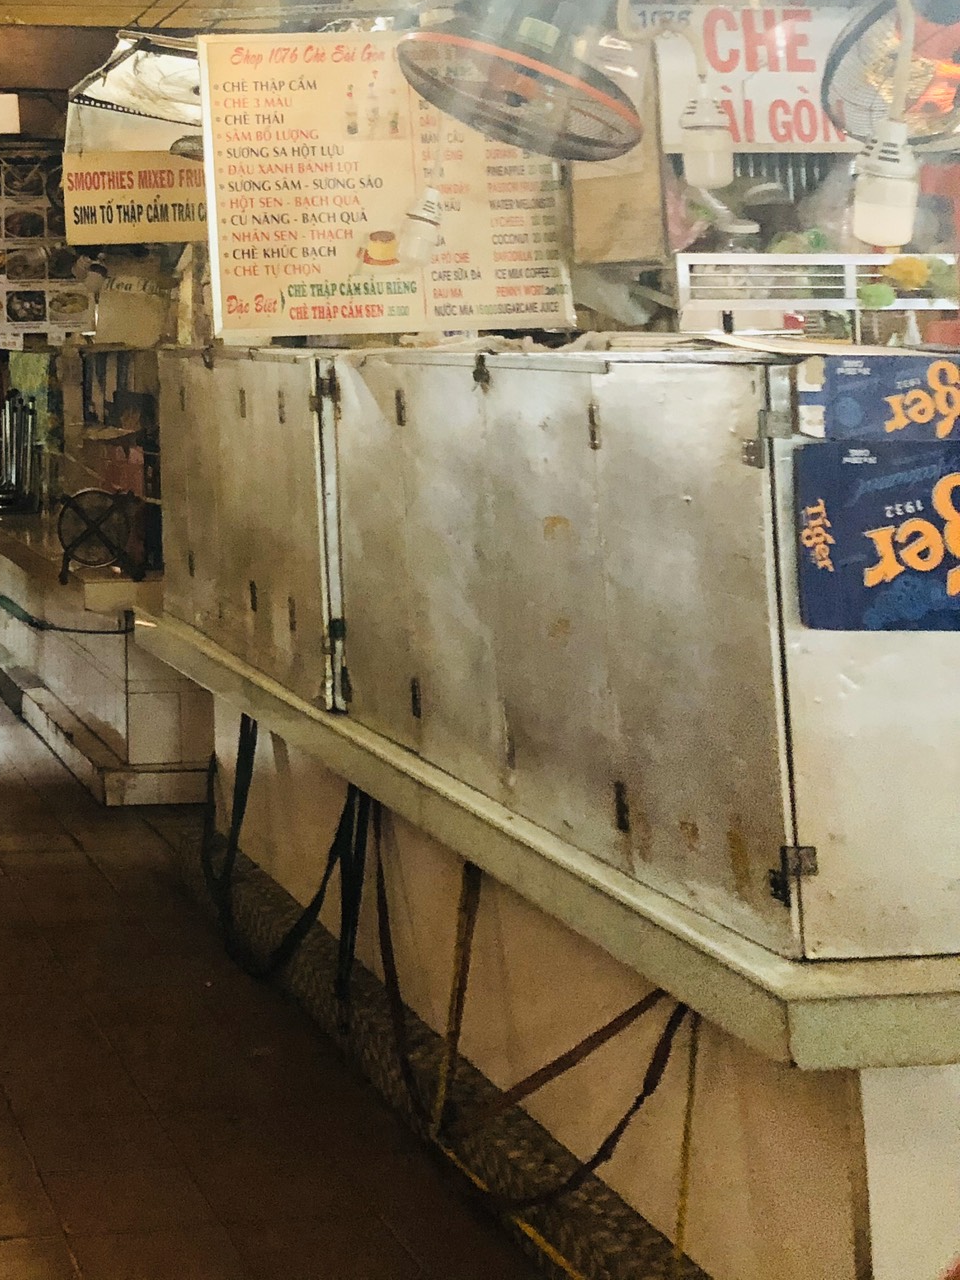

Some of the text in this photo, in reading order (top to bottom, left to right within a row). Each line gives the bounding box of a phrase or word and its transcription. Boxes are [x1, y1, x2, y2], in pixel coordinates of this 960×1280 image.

[269, 47, 298, 64] 1076
[222, 75, 318, 95] CHÈ THẬP CẨM
[254, 98, 260, 107] 3
[224, 113, 285, 125] CHÈ THÁI
[273, 146, 287, 157] SA
[292, 145, 316, 160] HỘT
[259, 163, 294, 174] XANH
[298, 160, 333, 173] BÁNH
[67, 170, 134, 191] SMOOTHIES
[138, 169, 175, 189] MIXED
[73, 204, 97, 225] SINH
[100, 198, 113, 224] TỐ
[116, 199, 143, 227] THẬP
[146, 194, 169, 223] CẨM
[171, 198, 195, 220] TRÁI
[230, 197, 255, 213] HỘT
[259, 196, 283, 208] SEN
[295, 196, 329, 210] BẠCH
[302, 212, 340, 227] BẠCH
[274, 230, 298, 241] SEN
[310, 229, 354, 241] THẠCH
[233, 244, 336, 261] CHÈ KHÚC BẠCH
[234, 264, 259, 277] CHÈ
[284, 263, 322, 277] CHỌN
[288, 280, 307, 297] CHÈ
[310, 279, 338, 299] THẬP
[340, 273, 361, 296] CẨM
[386, 278, 417, 295] RIÊNG
[290, 303, 309, 320] CHÈ
[312, 303, 339, 322] THẬP
[341, 297, 363, 318] CẨM
[365, 304, 385, 317] SEN
[884, 500, 924, 518] 1932
[801, 498, 836, 572] Tiger
